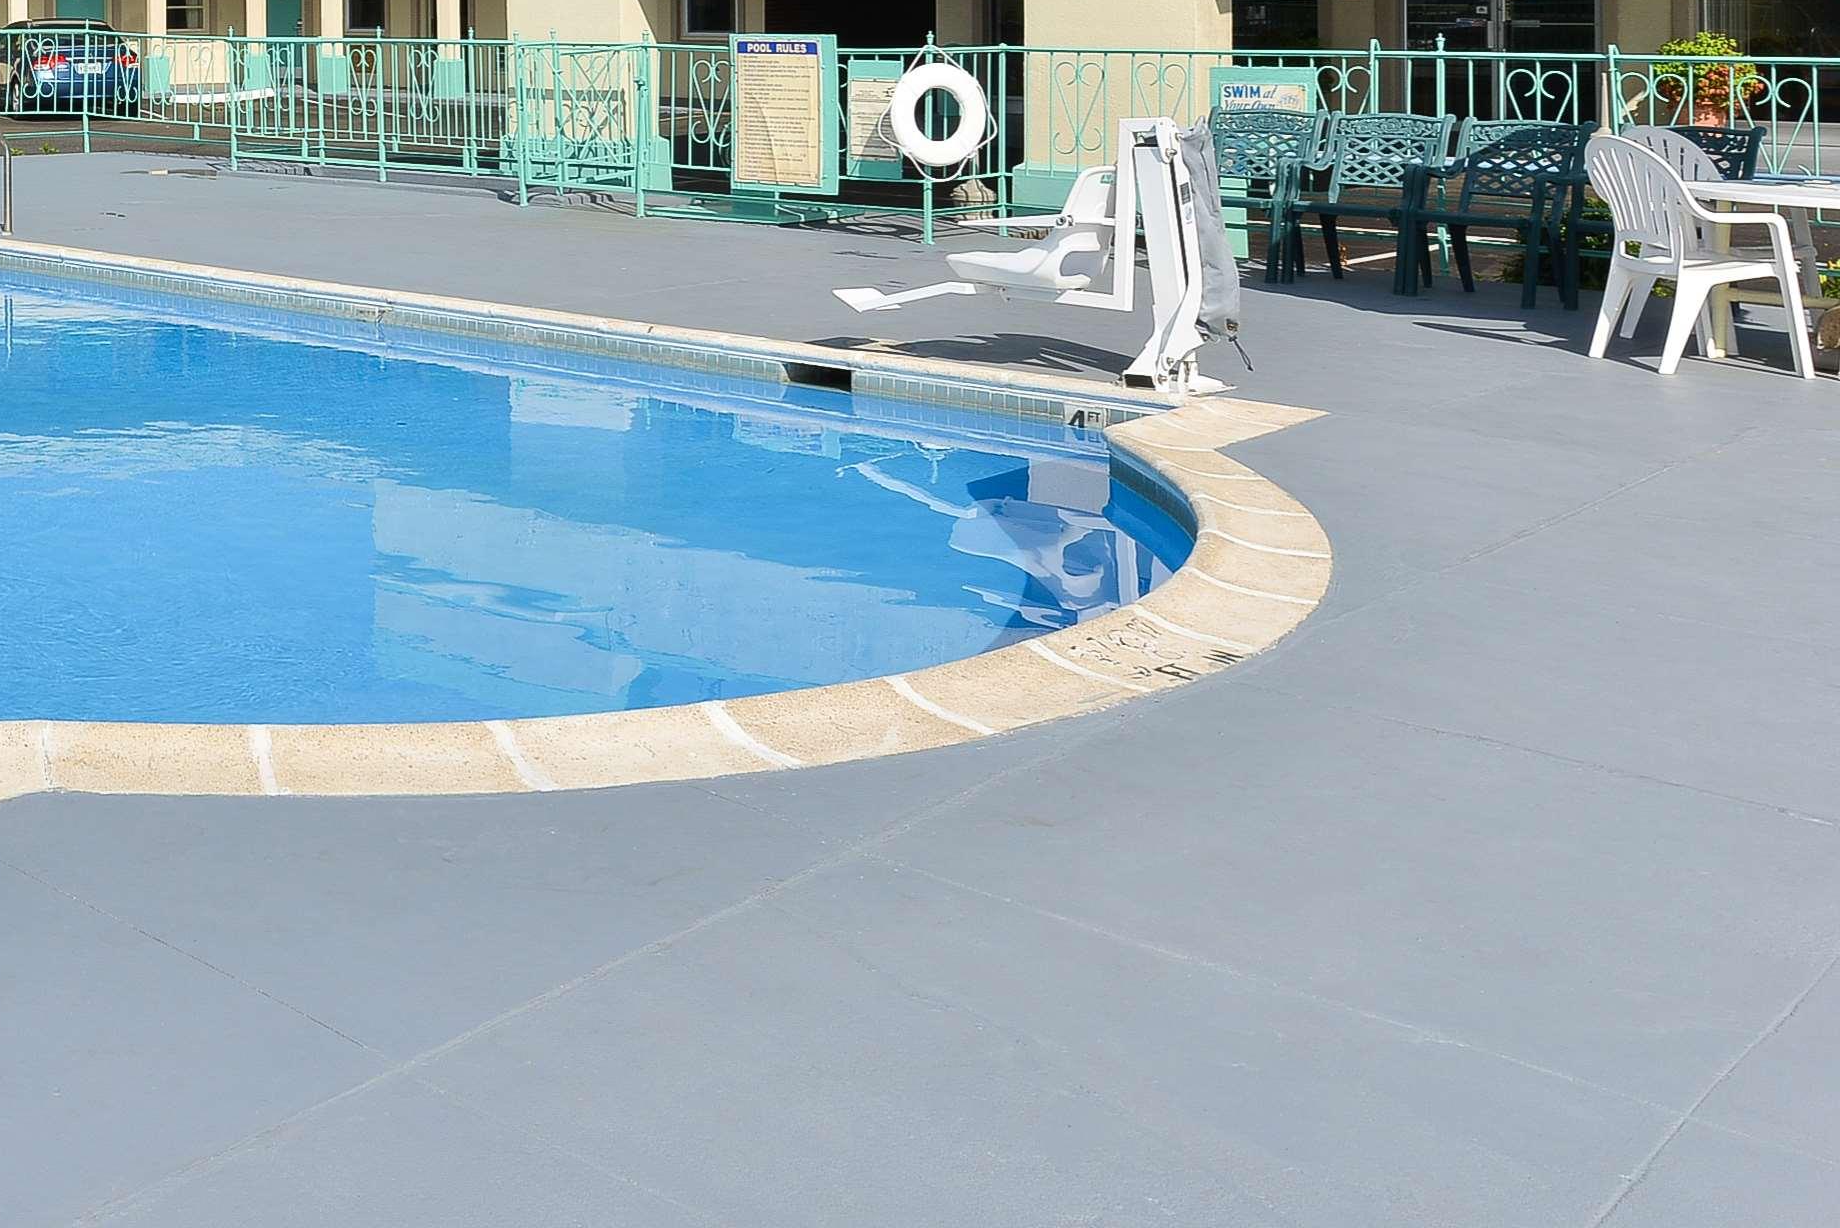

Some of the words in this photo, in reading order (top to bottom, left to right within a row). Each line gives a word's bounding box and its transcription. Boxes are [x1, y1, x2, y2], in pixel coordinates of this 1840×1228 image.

[747, 43, 772, 53] POOL
[776, 43, 807, 53] RULES
[1223, 85, 1260, 98] SWIM
[1262, 84, 1278, 99] at
[1224, 99, 1250, 110] Your
[1088, 411, 1101, 422] FT
